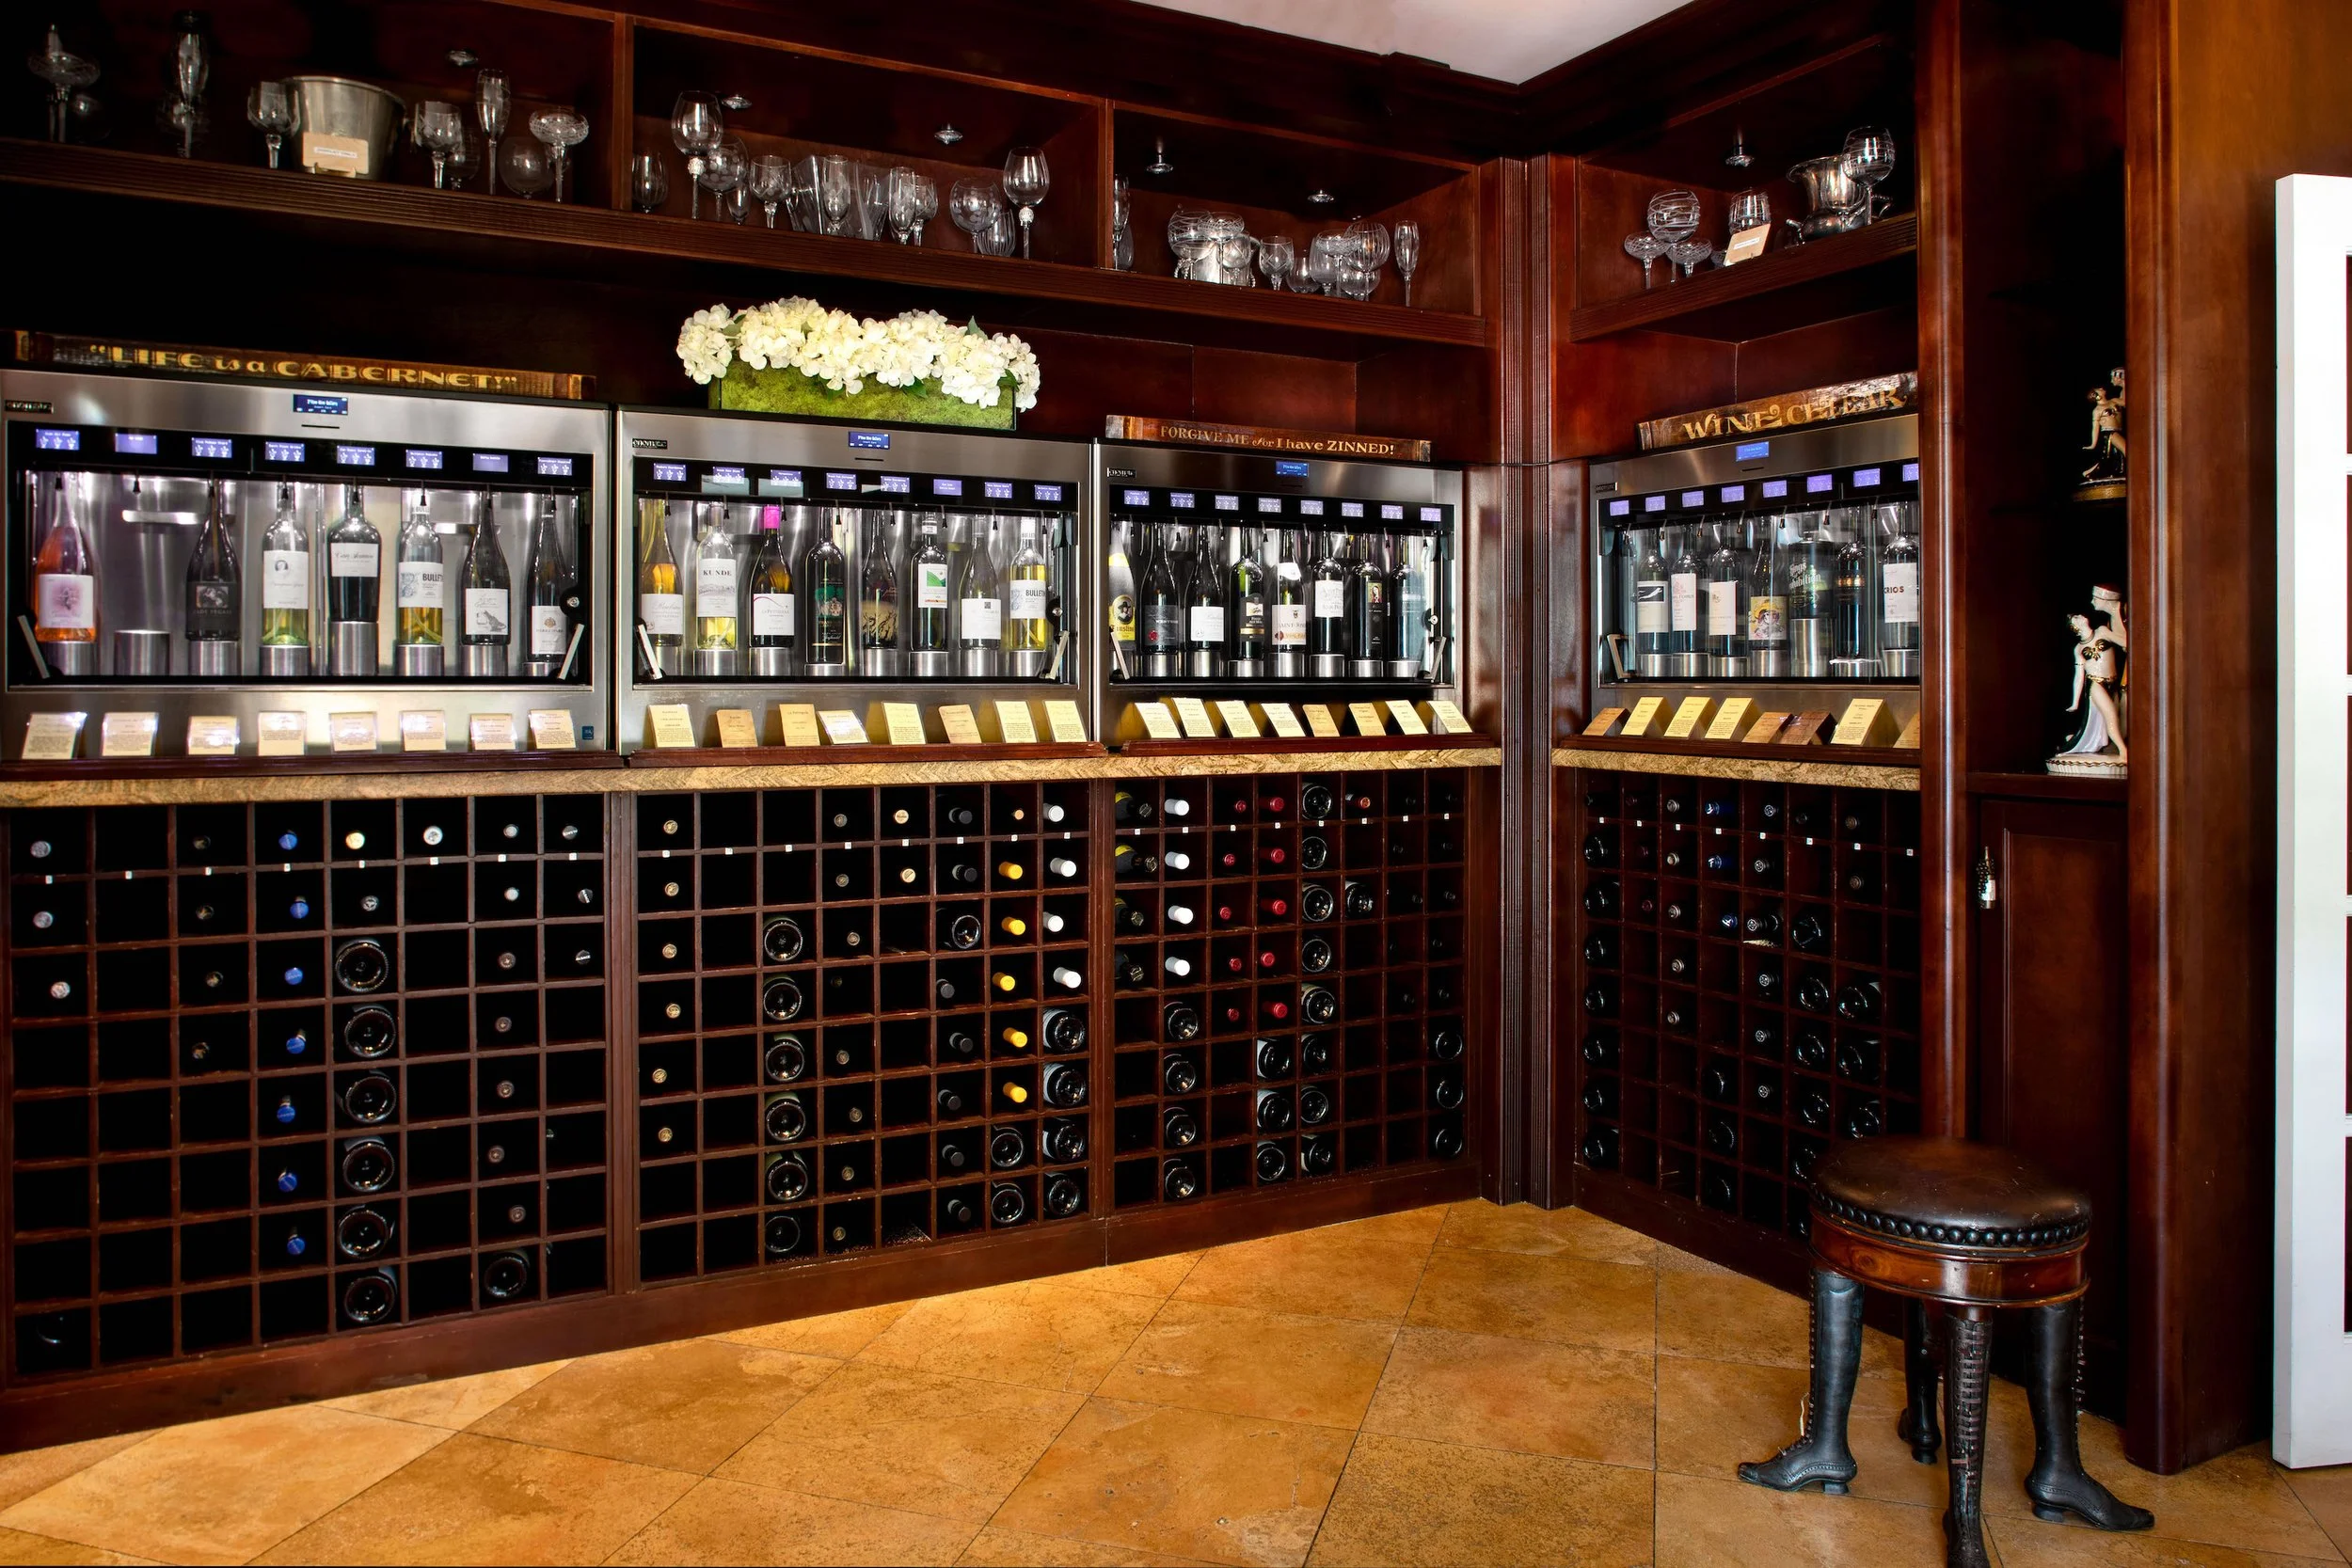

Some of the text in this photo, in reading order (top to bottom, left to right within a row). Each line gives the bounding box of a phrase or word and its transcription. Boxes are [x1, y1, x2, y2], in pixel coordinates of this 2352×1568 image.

[215, 356, 241, 371] is
[246, 361, 266, 372] a
[1682, 386, 1908, 440] WINE CELLAR
[1160, 425, 1395, 456] FORGIVE ME for I have ZINNED!
[1883, 585, 1905, 594] CRIOS
